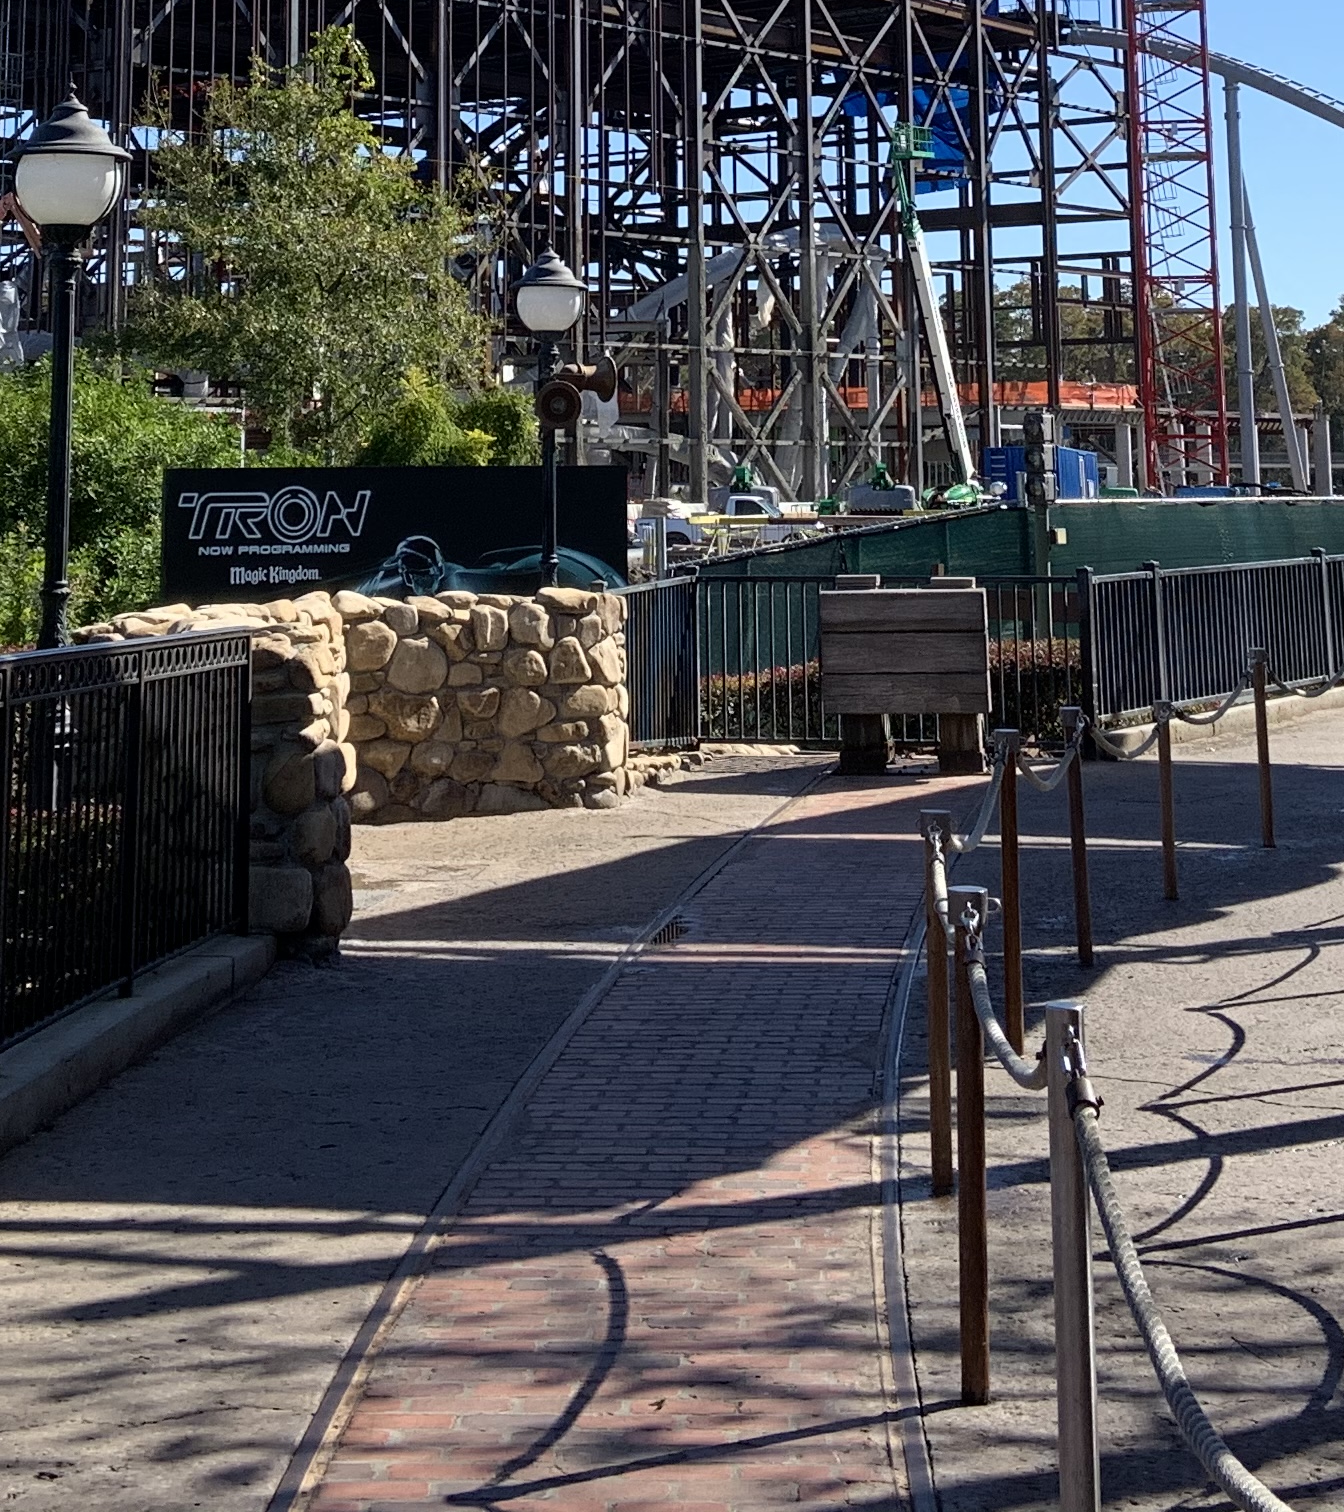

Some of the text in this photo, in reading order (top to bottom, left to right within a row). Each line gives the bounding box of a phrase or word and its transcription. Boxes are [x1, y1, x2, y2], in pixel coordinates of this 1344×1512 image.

[178, 486, 371, 543] TRON
[198, 543, 350, 556] NOW PROGRAMMING
[230, 566, 267, 584] Magic
